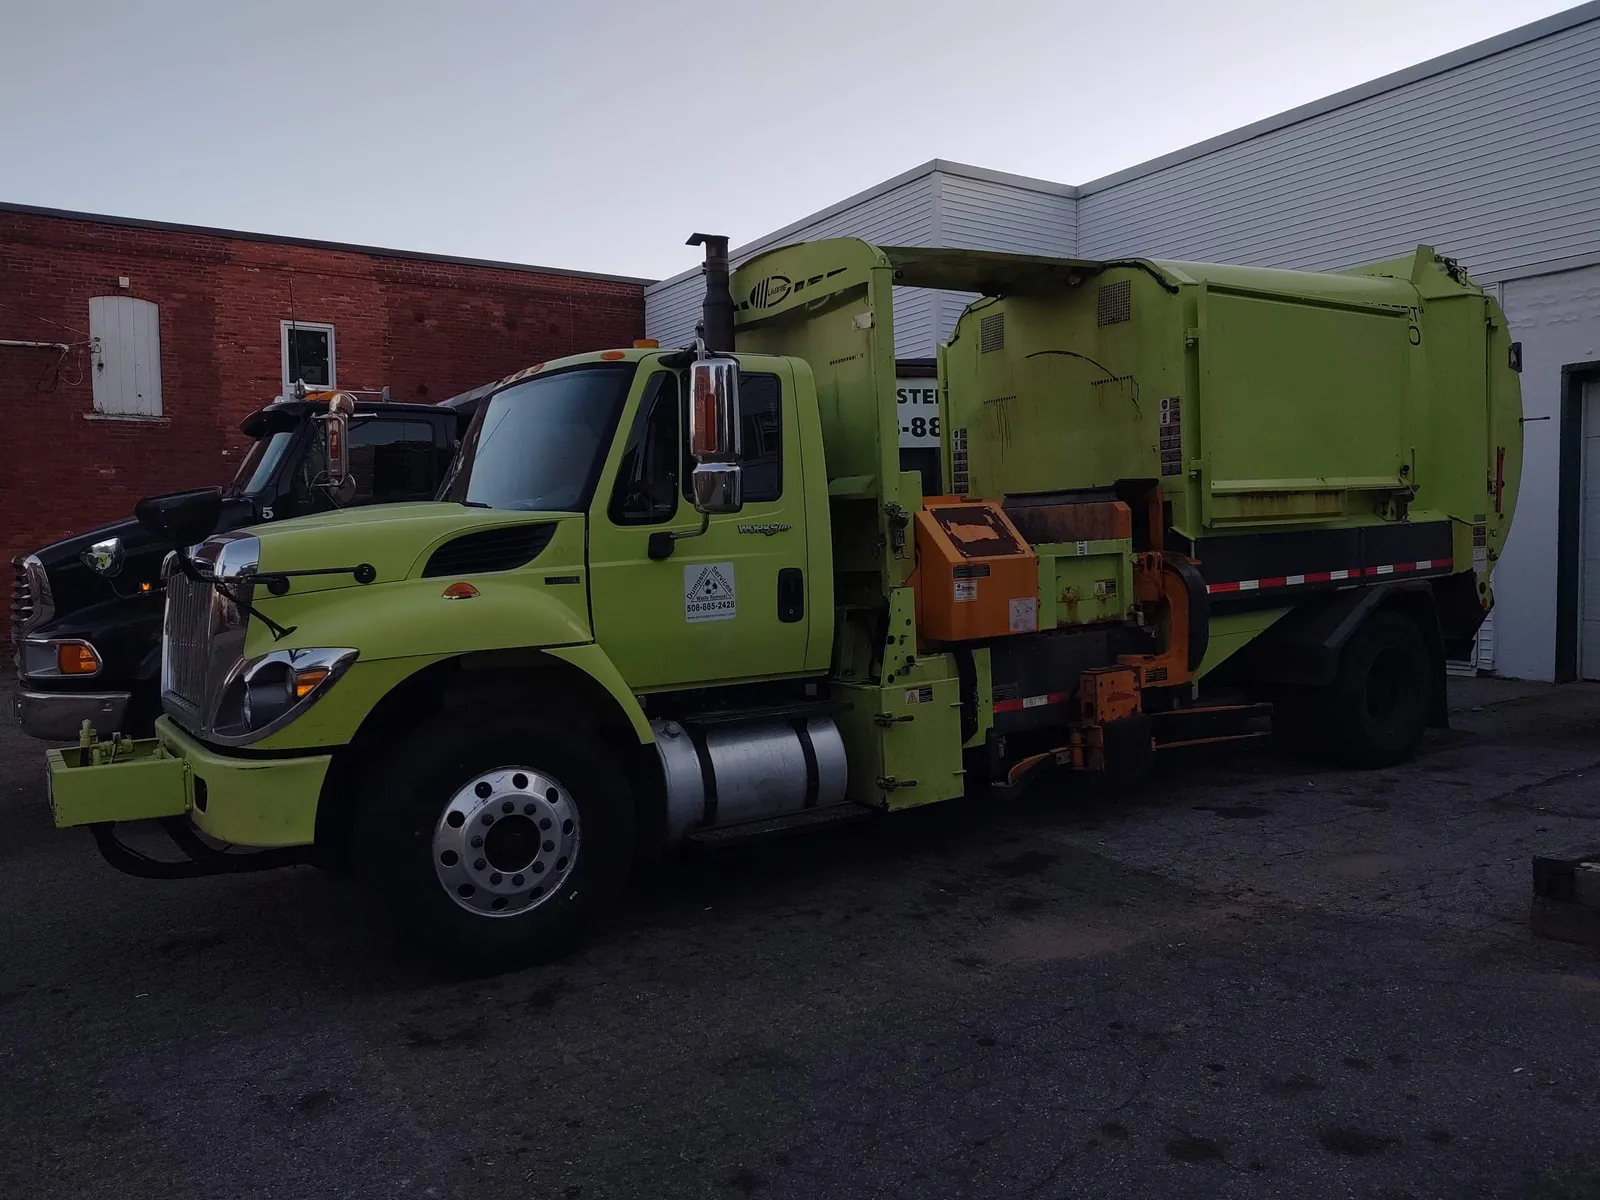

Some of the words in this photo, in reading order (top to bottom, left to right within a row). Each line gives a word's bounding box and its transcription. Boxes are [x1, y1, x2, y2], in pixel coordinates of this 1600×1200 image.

[262, 506, 274, 519] 5
[686, 566, 709, 600] Dumpster
[711, 565, 733, 593] Services
[686, 600, 735, 612] 508-885-2428
